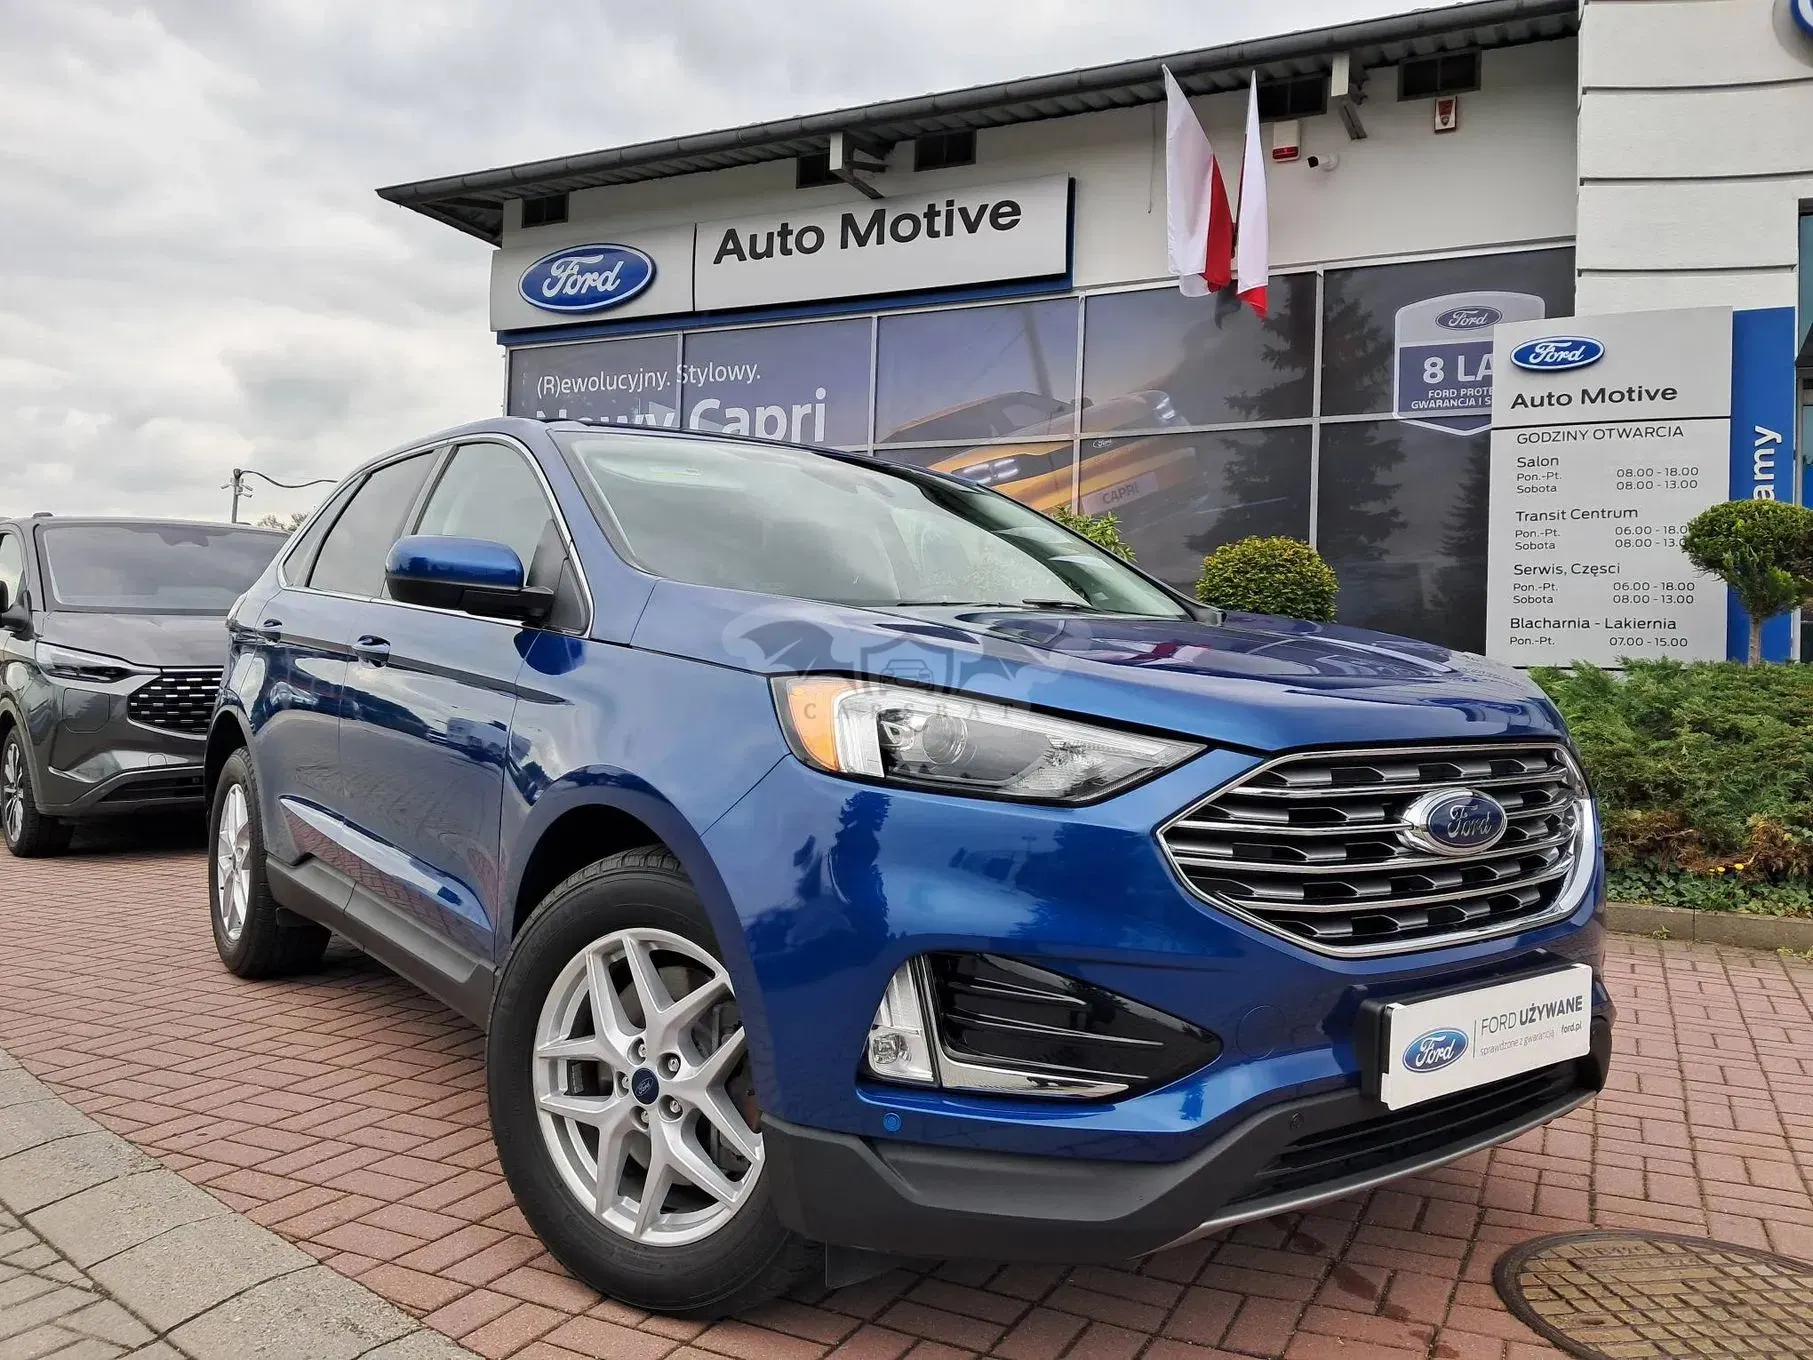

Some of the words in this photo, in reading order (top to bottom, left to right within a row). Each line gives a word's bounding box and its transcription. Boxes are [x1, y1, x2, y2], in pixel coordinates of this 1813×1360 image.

[713, 222, 826, 265] Auto
[840, 198, 1022, 250] Motive
[542, 254, 624, 298] Ford
[1448, 309, 1489, 327] Ford
[1529, 341, 1585, 364] Ford
[1423, 356, 1445, 384] 8
[1457, 353, 1494, 382] LA
[537, 367, 671, 399] (R)ewolucyjny.
[676, 362, 761, 388] Stylowy.
[1428, 389, 1458, 399] FORD
[1460, 386, 1494, 397] PROTE
[1510, 391, 1573, 409] Auto
[1580, 385, 1678, 405] Motive
[1411, 397, 1476, 409] GWARANCJA
[689, 387, 827, 443] Capri
[1516, 429, 1589, 445] GODZINY
[1593, 425, 1684, 441] OTWARCIA
[1516, 455, 1560, 469] Salon
[1753, 425, 1783, 500] amy
[1616, 467, 1654, 478] 08.00
[1664, 466, 1699, 477] 18.00
[1102, 481, 1140, 504] CAPRI
[1516, 483, 1557, 494] Sobota
[1616, 480, 1654, 491] 08.00
[1664, 479, 1698, 490] 13.00
[1515, 509, 1567, 523] Transit
[1570, 507, 1639, 521] Centrum
[1615, 526, 1652, 536] 06.00
[1663, 525, 1688, 535] 18.0
[1515, 541, 1556, 552] Sobota
[1663, 538, 1687, 547] 13.0
[1513, 563, 1567, 576] Serwis,
[1612, 581, 1651, 592] 06.00
[1661, 581, 1696, 592] 18.00
[1512, 594, 1554, 605] Sobota
[1612, 594, 1651, 604] 08.00
[1661, 594, 1695, 605] 13.00
[1510, 617, 1591, 630] Blacharnia
[1604, 617, 1677, 630] Lakiernia
[1609, 637, 1645, 647] 07.00
[1654, 637, 1689, 647] 15.00
[1447, 804, 1492, 838] Ford
[1481, 1012, 1517, 1036] FORD
[1520, 996, 1583, 1026] UŻYWANE
[1561, 1020, 1583, 1035] ford.pl
[1416, 1034, 1456, 1067] Ford
